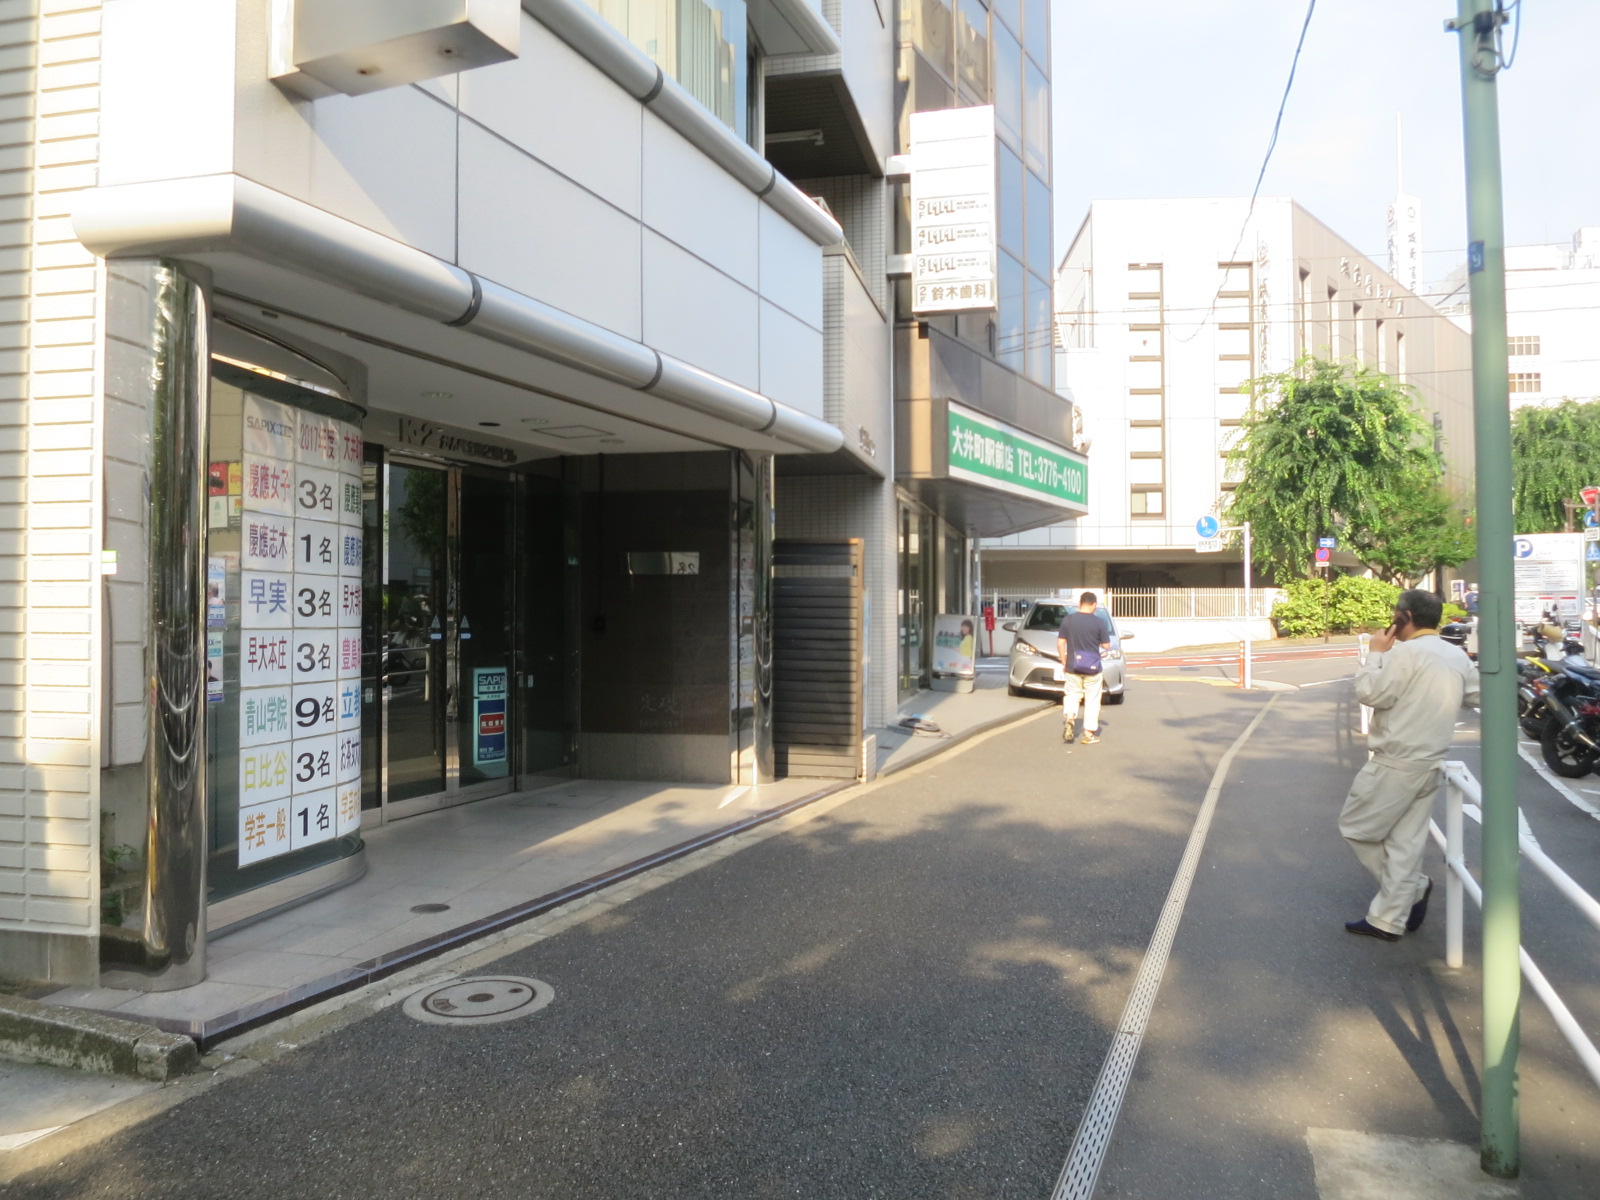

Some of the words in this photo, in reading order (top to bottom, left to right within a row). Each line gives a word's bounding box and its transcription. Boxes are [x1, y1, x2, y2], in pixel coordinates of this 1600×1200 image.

[931, 283, 987, 301] 鈴木歯科
[952, 425, 1014, 474] 大井町駅前店
[248, 463, 291, 502] 慶應女子
[299, 479, 333, 511] 3名
[248, 522, 288, 560] 慶應志木
[300, 533, 332, 565] 1名
[248, 579, 288, 615] 早実
[297, 587, 332, 618] 3名
[247, 636, 287, 672] 早大本庄
[296, 642, 331, 673] 3名
[245, 695, 287, 736] 青山学院
[295, 696, 335, 728] 9名
[244, 750, 287, 791] 日比谷
[296, 750, 330, 783] 3名
[244, 807, 287, 850] 学芸一般
[297, 803, 330, 837] 1名
